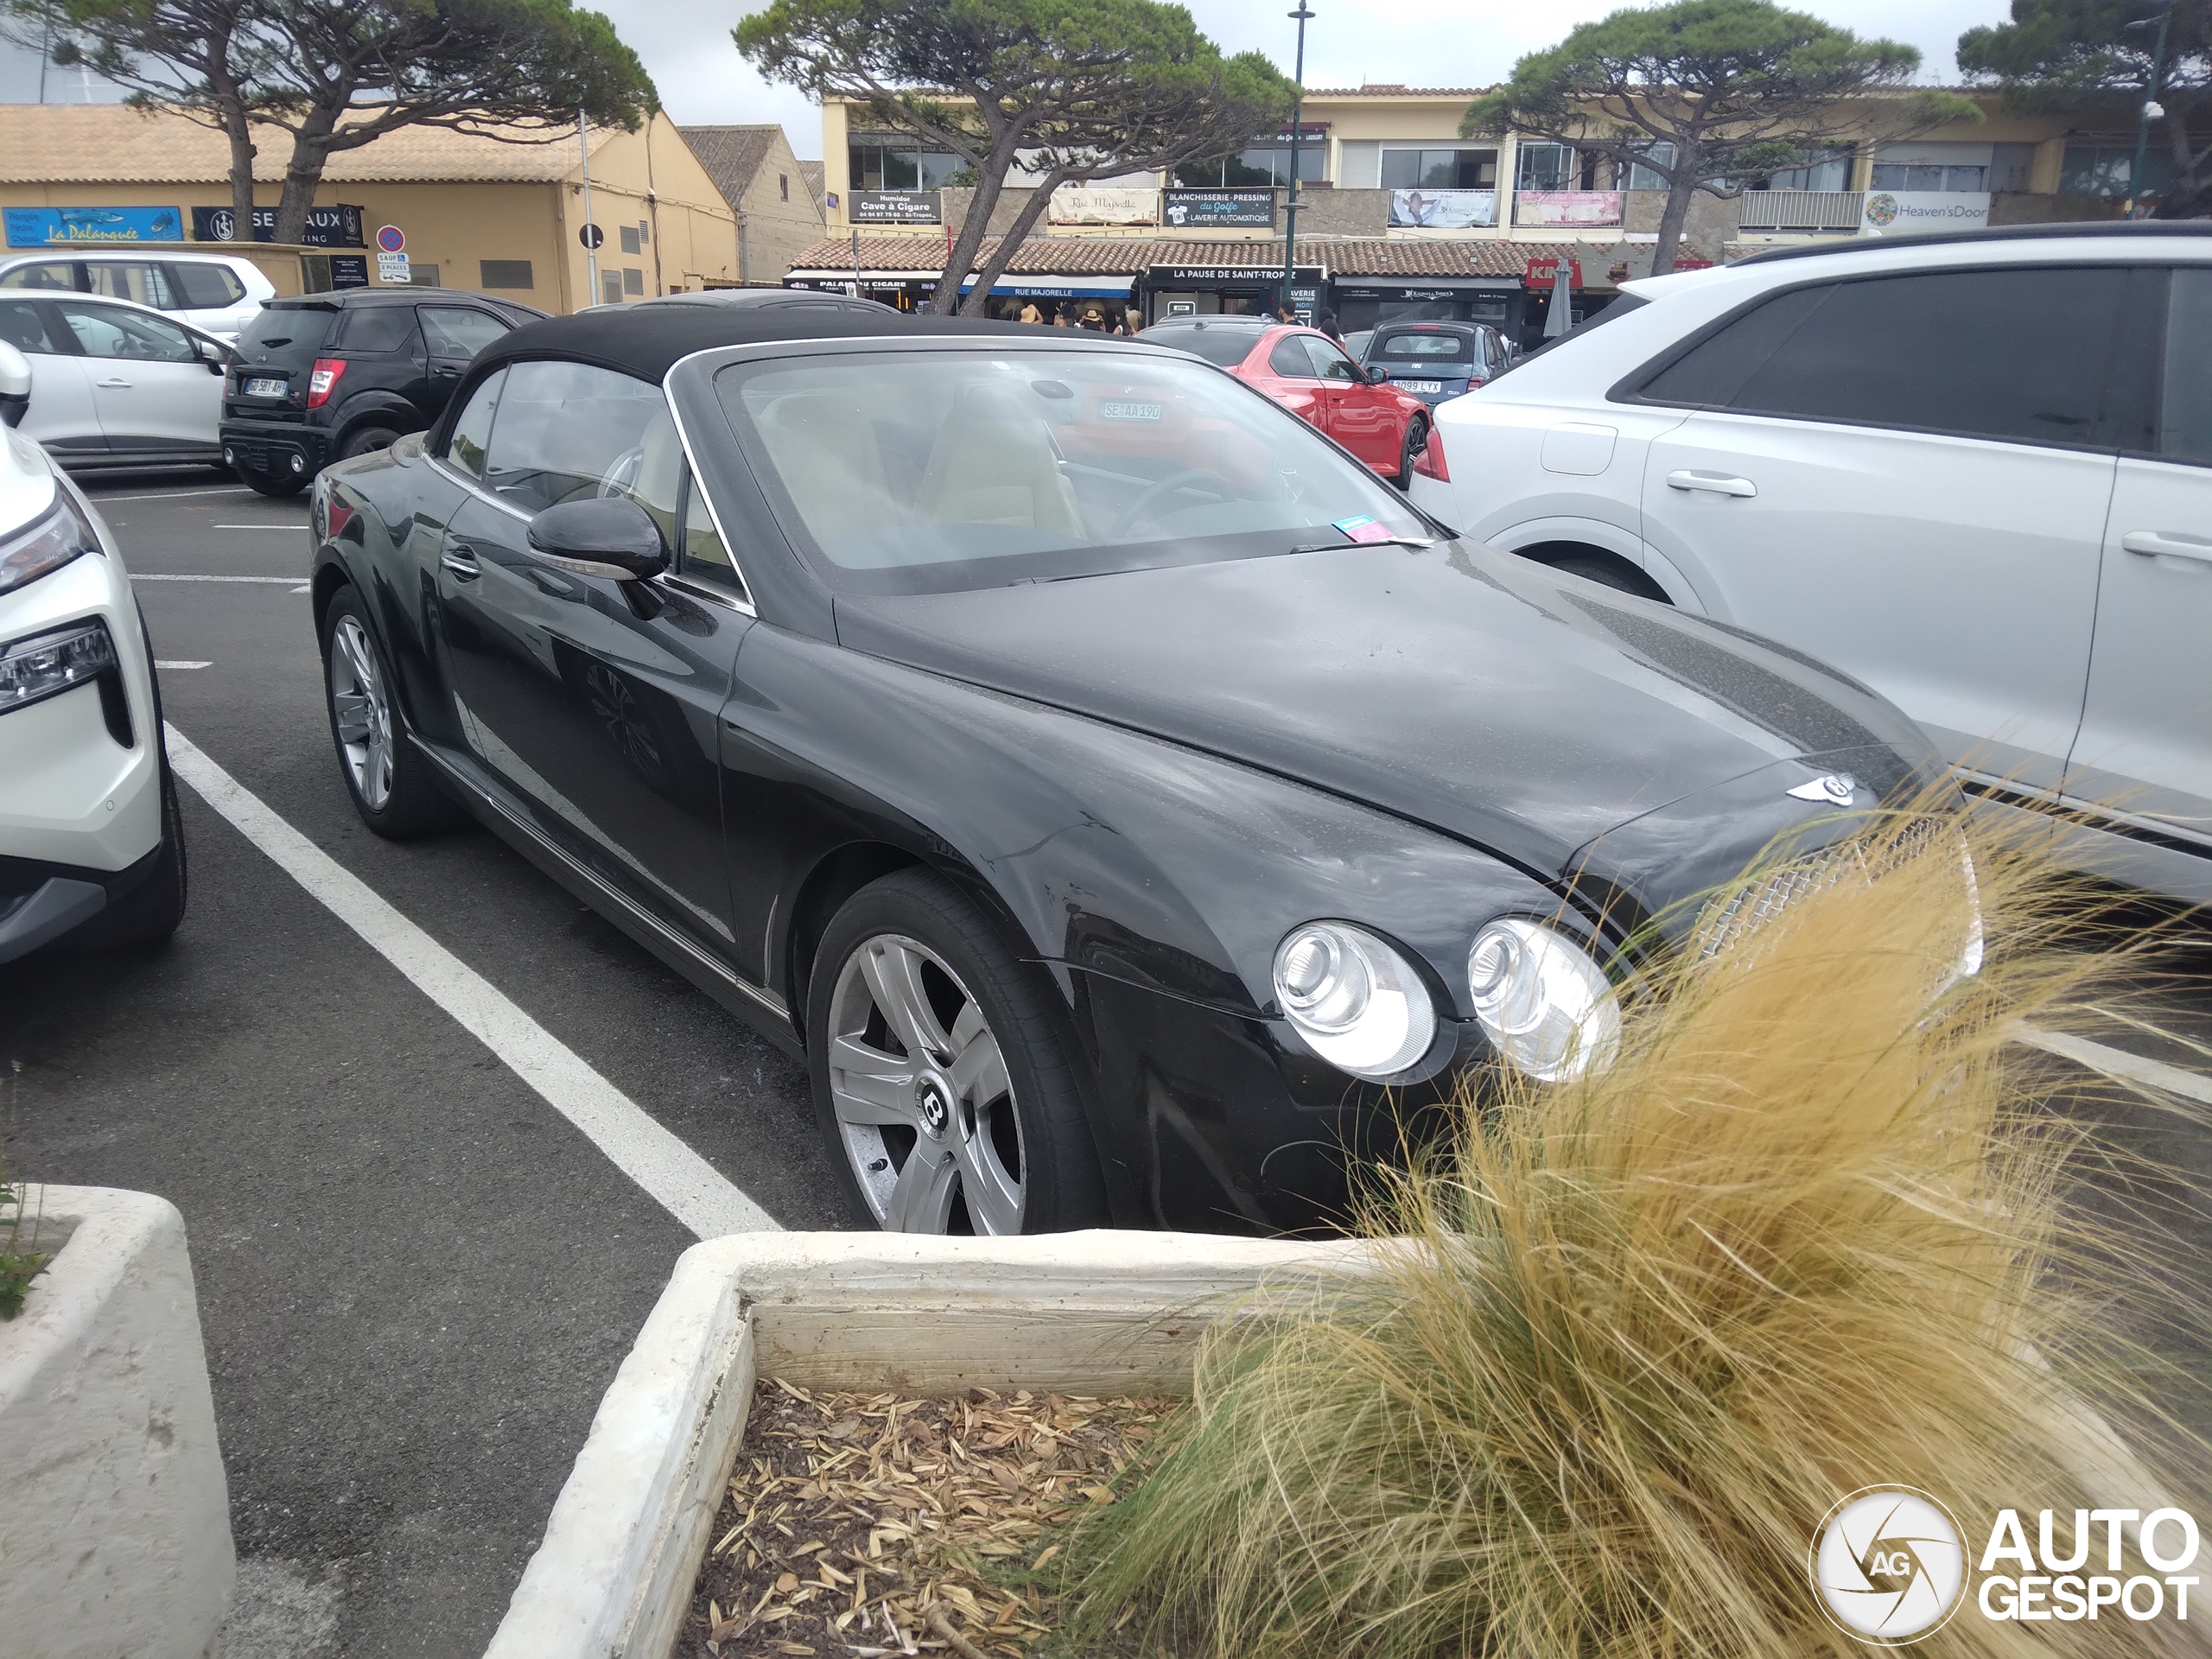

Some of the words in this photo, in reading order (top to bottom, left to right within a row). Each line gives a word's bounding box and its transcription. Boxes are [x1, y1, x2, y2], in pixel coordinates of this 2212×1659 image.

[861, 202, 886, 211] Cave
[888, 201, 895, 211] à
[897, 202, 931, 212] Cigare
[1068, 197, 1089, 208] Rue
[1090, 197, 1136, 210] Majorelle
[1213, 201, 1239, 213] Golfe
[252, 212, 341, 227] SEAUX
[48, 225, 65, 240] La
[68, 223, 139, 241] Palanquée
[1173, 270, 1185, 278] LA
[1187, 270, 1216, 278] PAUSE
[1231, 270, 1296, 279] SAINT-TROPZ
[1421, 382, 1439, 391] LYX
[1106, 404, 1119, 416] SE
[1124, 404, 1138, 417] AA
[1139, 405, 1160, 418] 190
